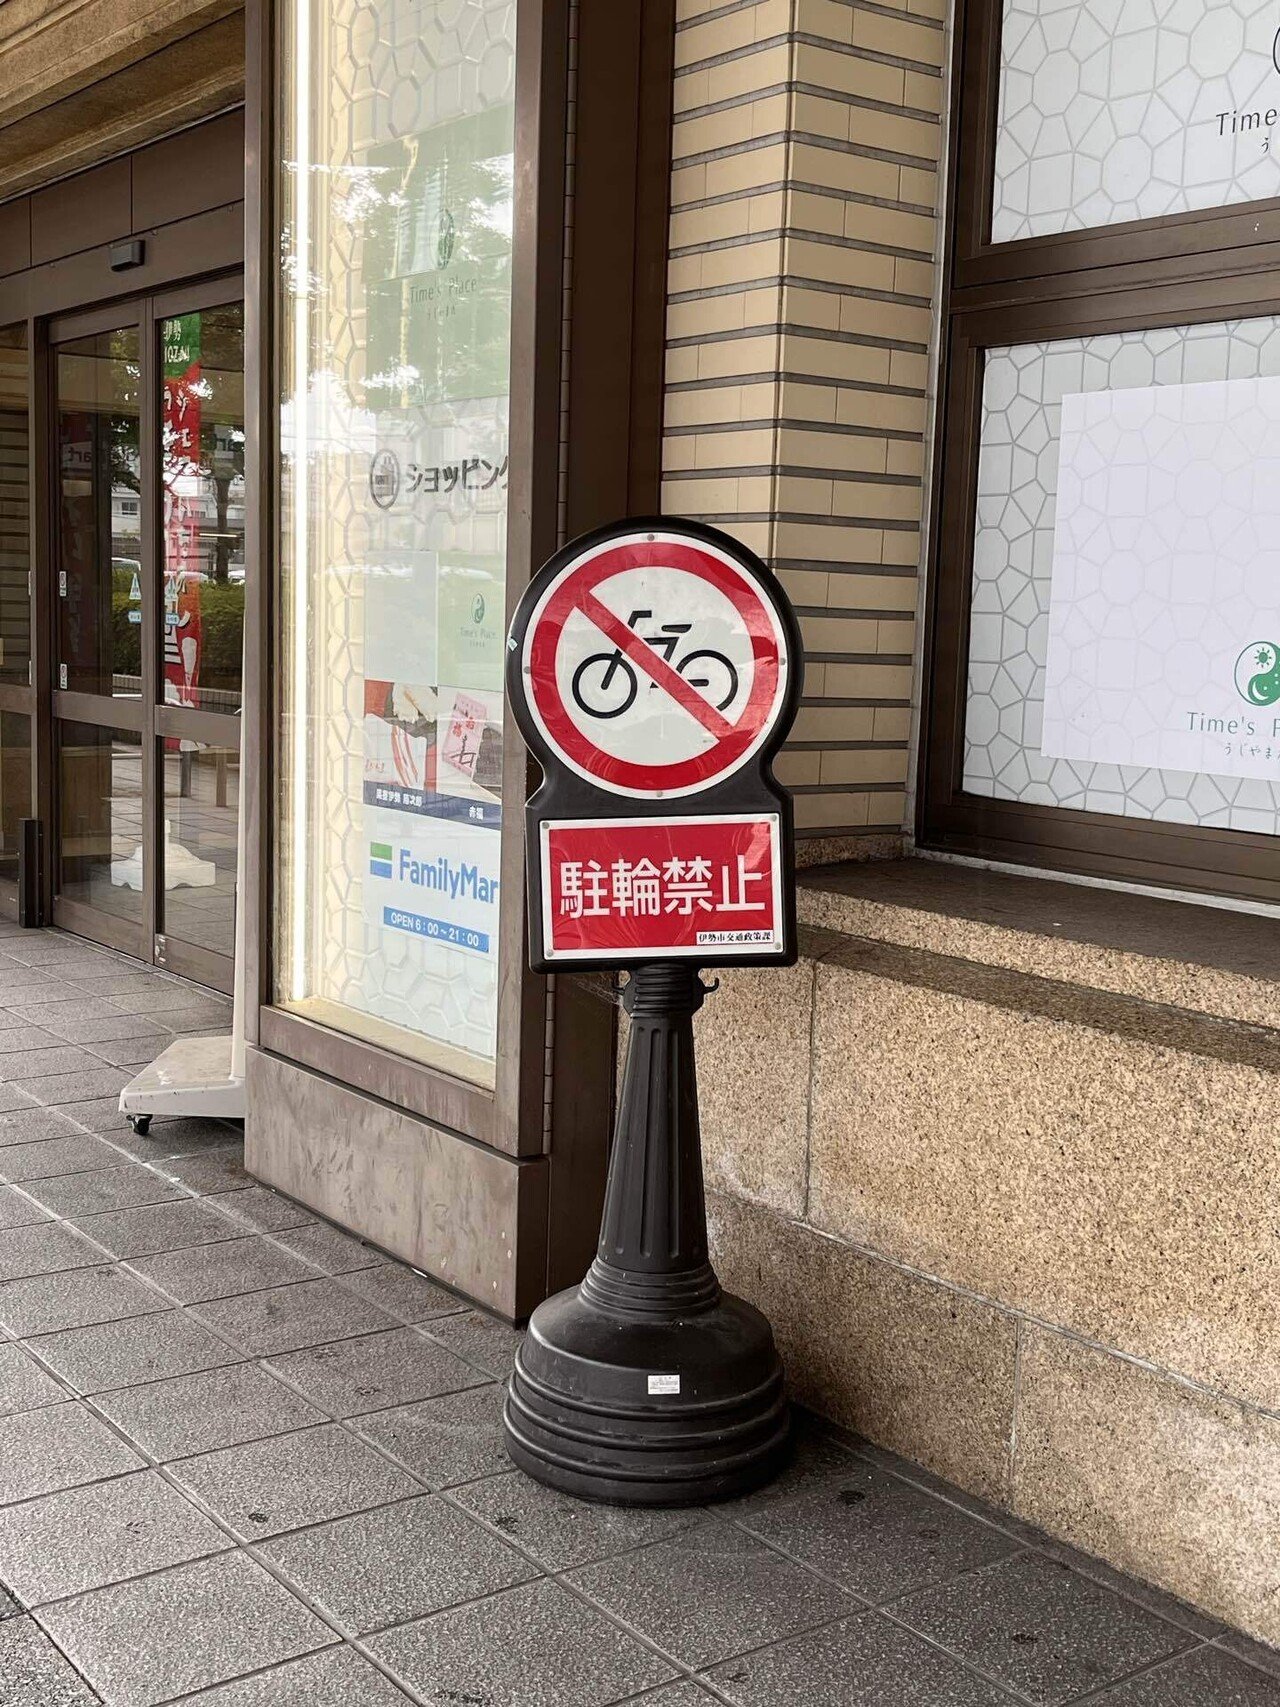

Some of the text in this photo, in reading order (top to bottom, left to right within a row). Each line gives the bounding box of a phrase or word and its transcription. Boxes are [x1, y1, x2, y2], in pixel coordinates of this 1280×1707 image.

[1187, 711, 1255, 736] Time's
[1224, 742, 1280, 760] うじやま
[560, 855, 766, 919] 駐輪禁止
[390, 912, 414, 930] OPEN
[698, 931, 771, 943] 伊勢市交通政策課
